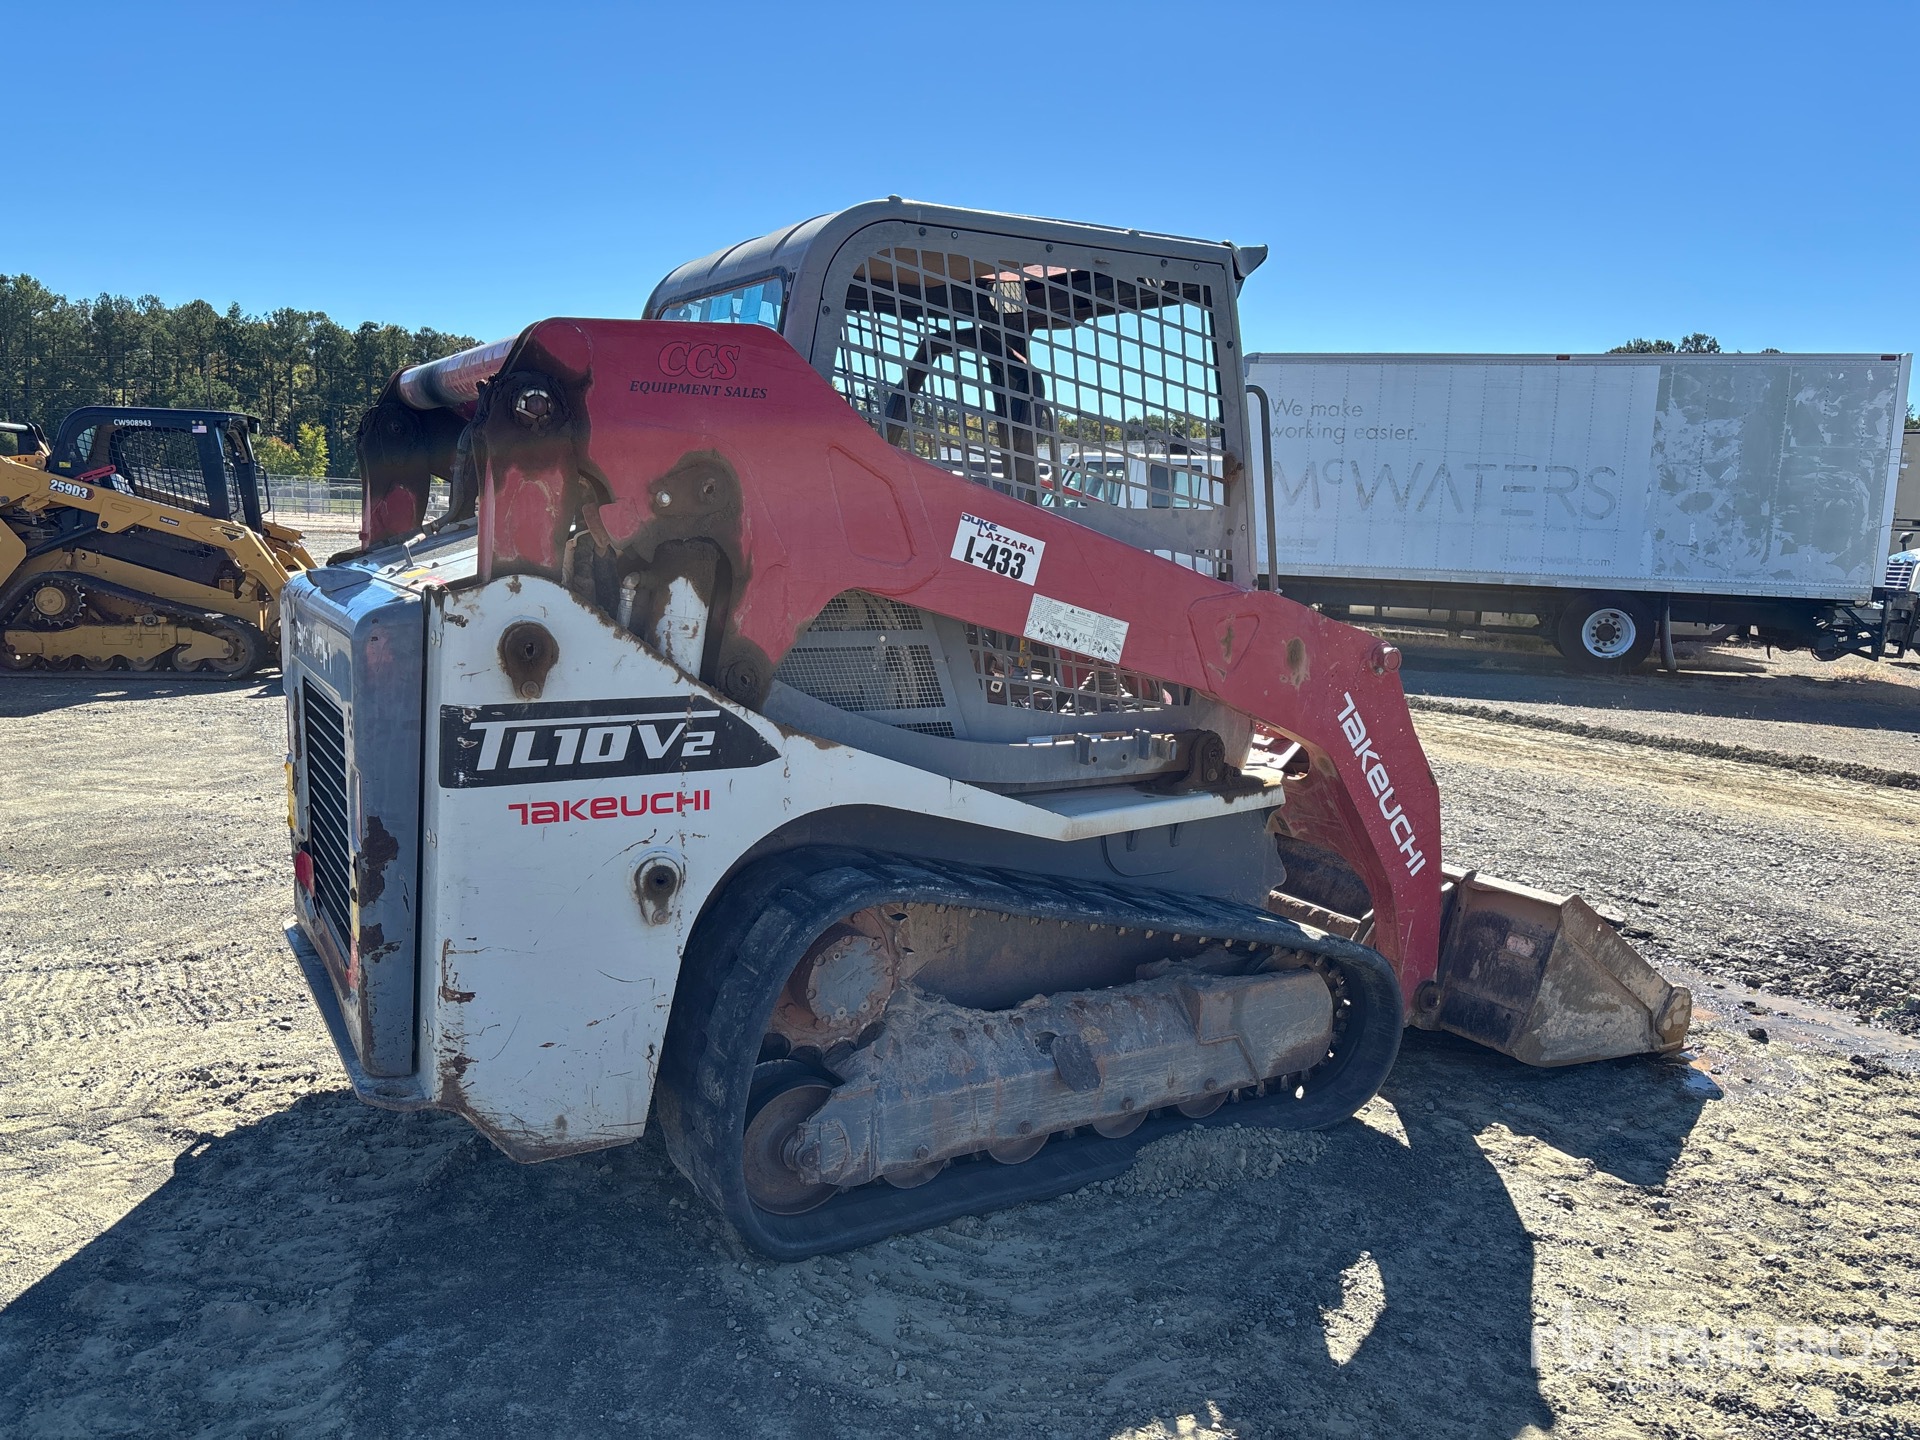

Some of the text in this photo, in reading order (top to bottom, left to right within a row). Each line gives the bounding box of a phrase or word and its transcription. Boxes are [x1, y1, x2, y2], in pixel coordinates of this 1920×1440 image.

[658, 340, 740, 380] CCS
[629, 380, 768, 399] EQUIPMENT SALES
[1270, 397, 1364, 418] We make
[113, 418, 152, 427] CW908943
[1270, 419, 1346, 445] working
[50, 479, 89, 499] 259D3
[961, 513, 998, 532] DUKE
[976, 527, 1036, 555] LAZZARA
[963, 535, 1027, 580] L-433
[1337, 691, 1427, 877] TAKEUCHI
[508, 788, 711, 826] TAKEUCHI
